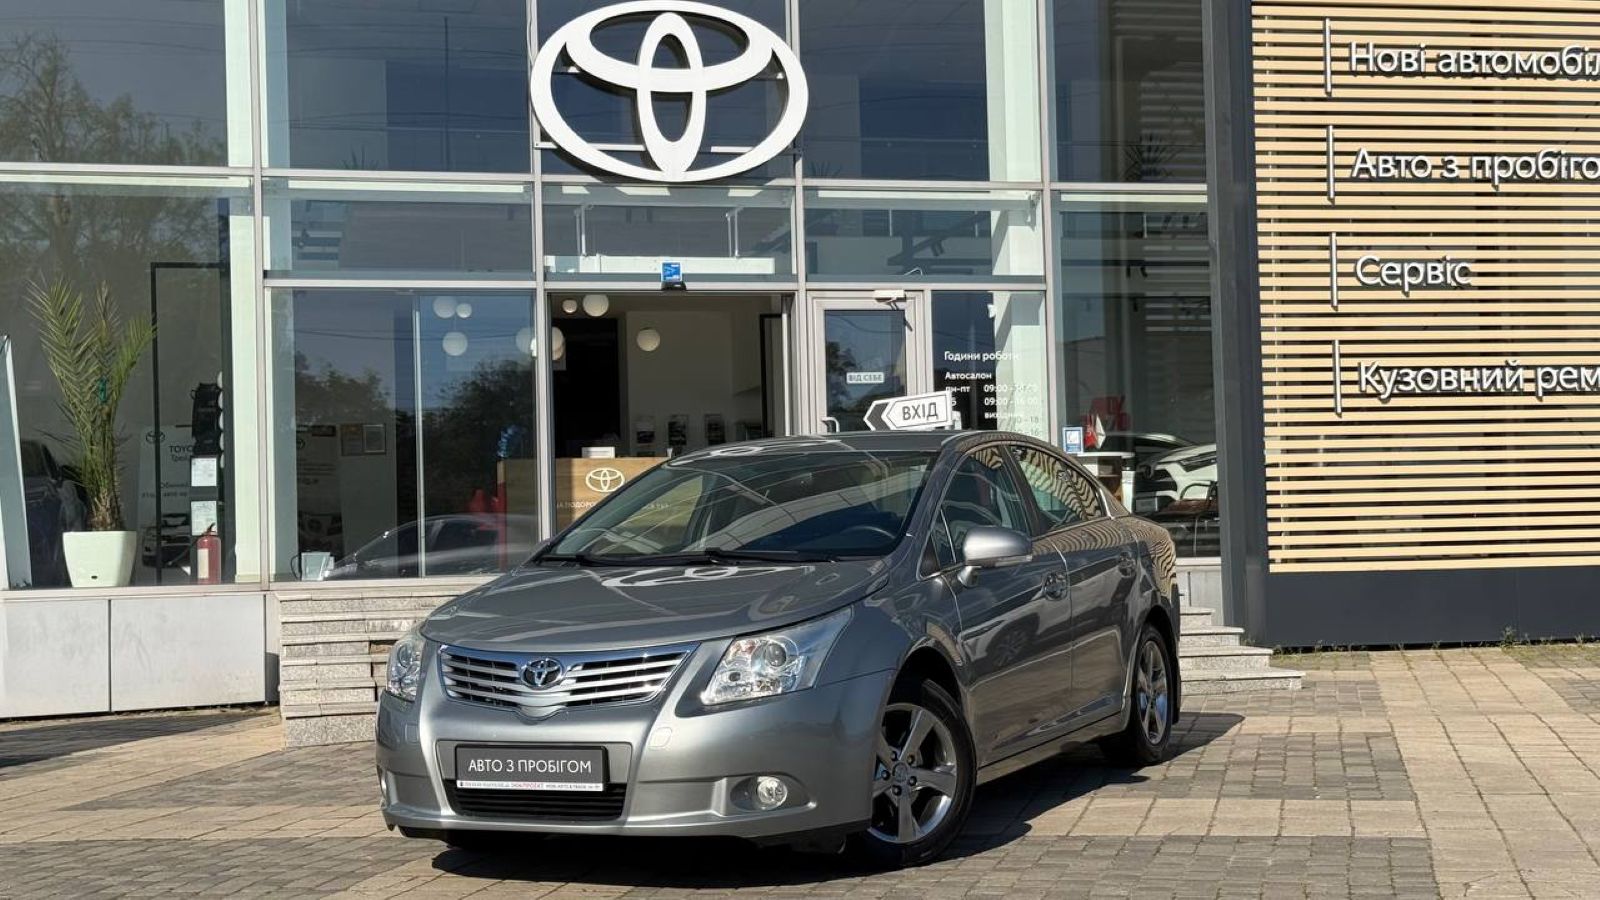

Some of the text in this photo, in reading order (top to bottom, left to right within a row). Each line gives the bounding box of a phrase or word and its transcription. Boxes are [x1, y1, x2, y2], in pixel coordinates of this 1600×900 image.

[1350, 42, 1426, 72] Нові
[1351, 148, 1432, 178] Авто
[1442, 155, 1460, 178] з
[1355, 255, 1472, 292] Сервіс
[944, 351, 980, 361] Години
[945, 372, 992, 380] Автосалон
[1359, 360, 1600, 399] Кузовний рем
[902, 402, 939, 421] ВХІД
[468, 759, 503, 772] АВТО
[518, 760, 591, 773] ПРОБІГОМ
